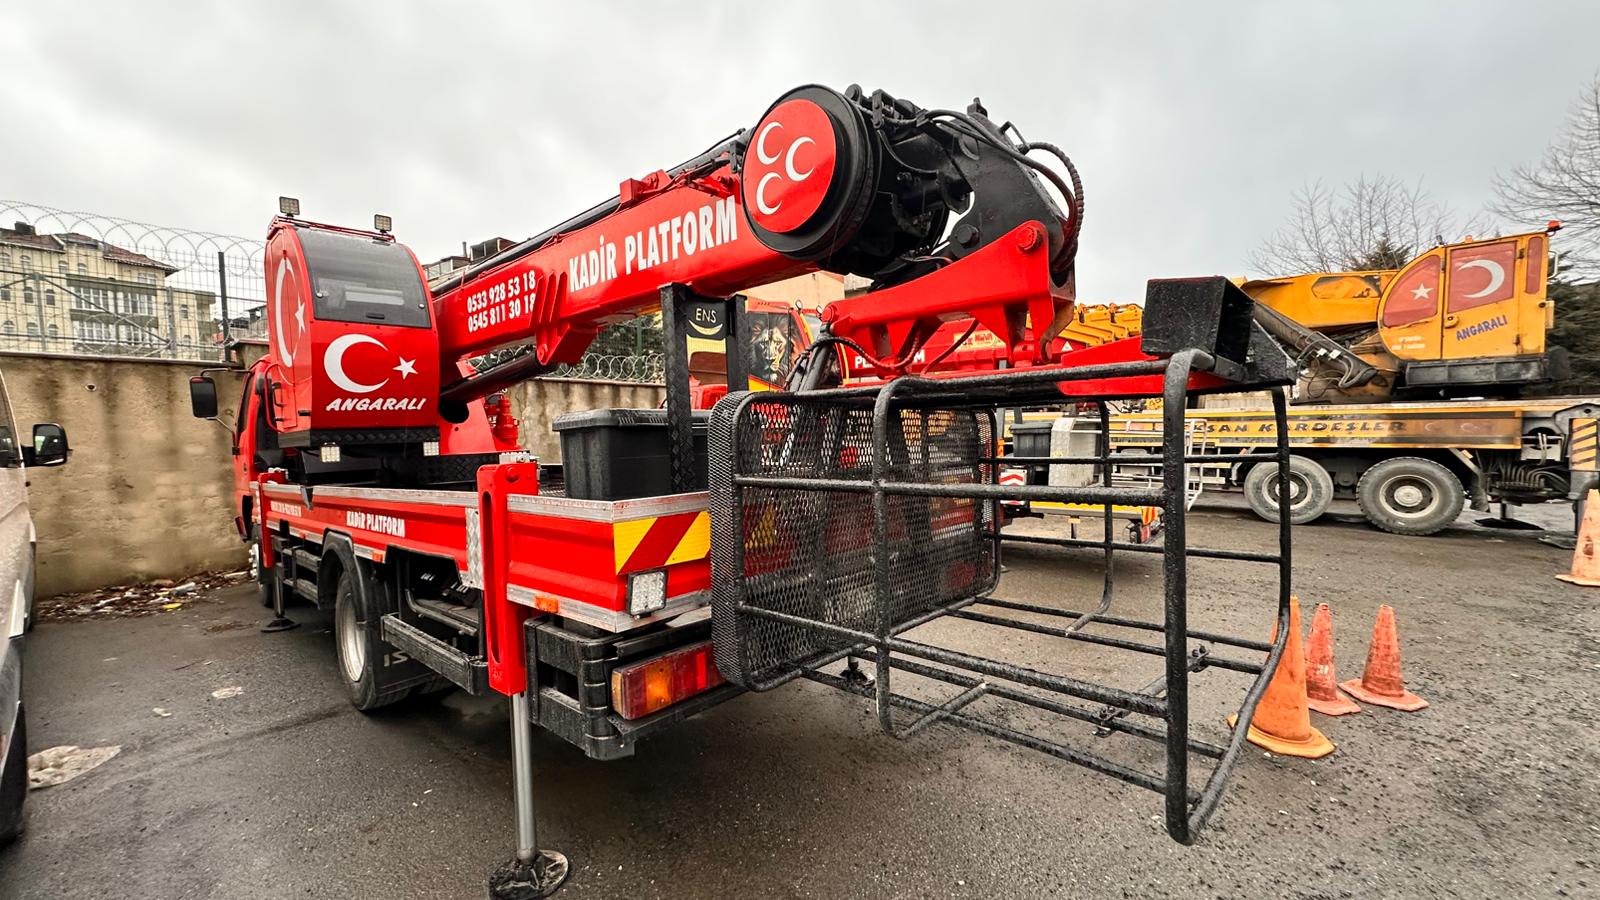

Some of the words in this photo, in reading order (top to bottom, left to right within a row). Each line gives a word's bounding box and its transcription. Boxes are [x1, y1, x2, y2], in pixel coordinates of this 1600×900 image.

[569, 235, 618, 293] KADİR
[625, 195, 738, 275] PLATFORM
[467, 290, 488, 314] 0533
[489, 282, 506, 305] 928
[508, 276, 521, 298] 53
[523, 270, 536, 290] 18
[468, 310, 489, 333] 0545
[490, 303, 506, 326] 811
[509, 298, 521, 319] 30
[524, 292, 536, 314] 18
[695, 308, 717, 323] ENS
[1456, 314, 1508, 341] ANGARALI
[326, 397, 427, 411] ANGARALI
[366, 513, 406, 538] PLATFORM
